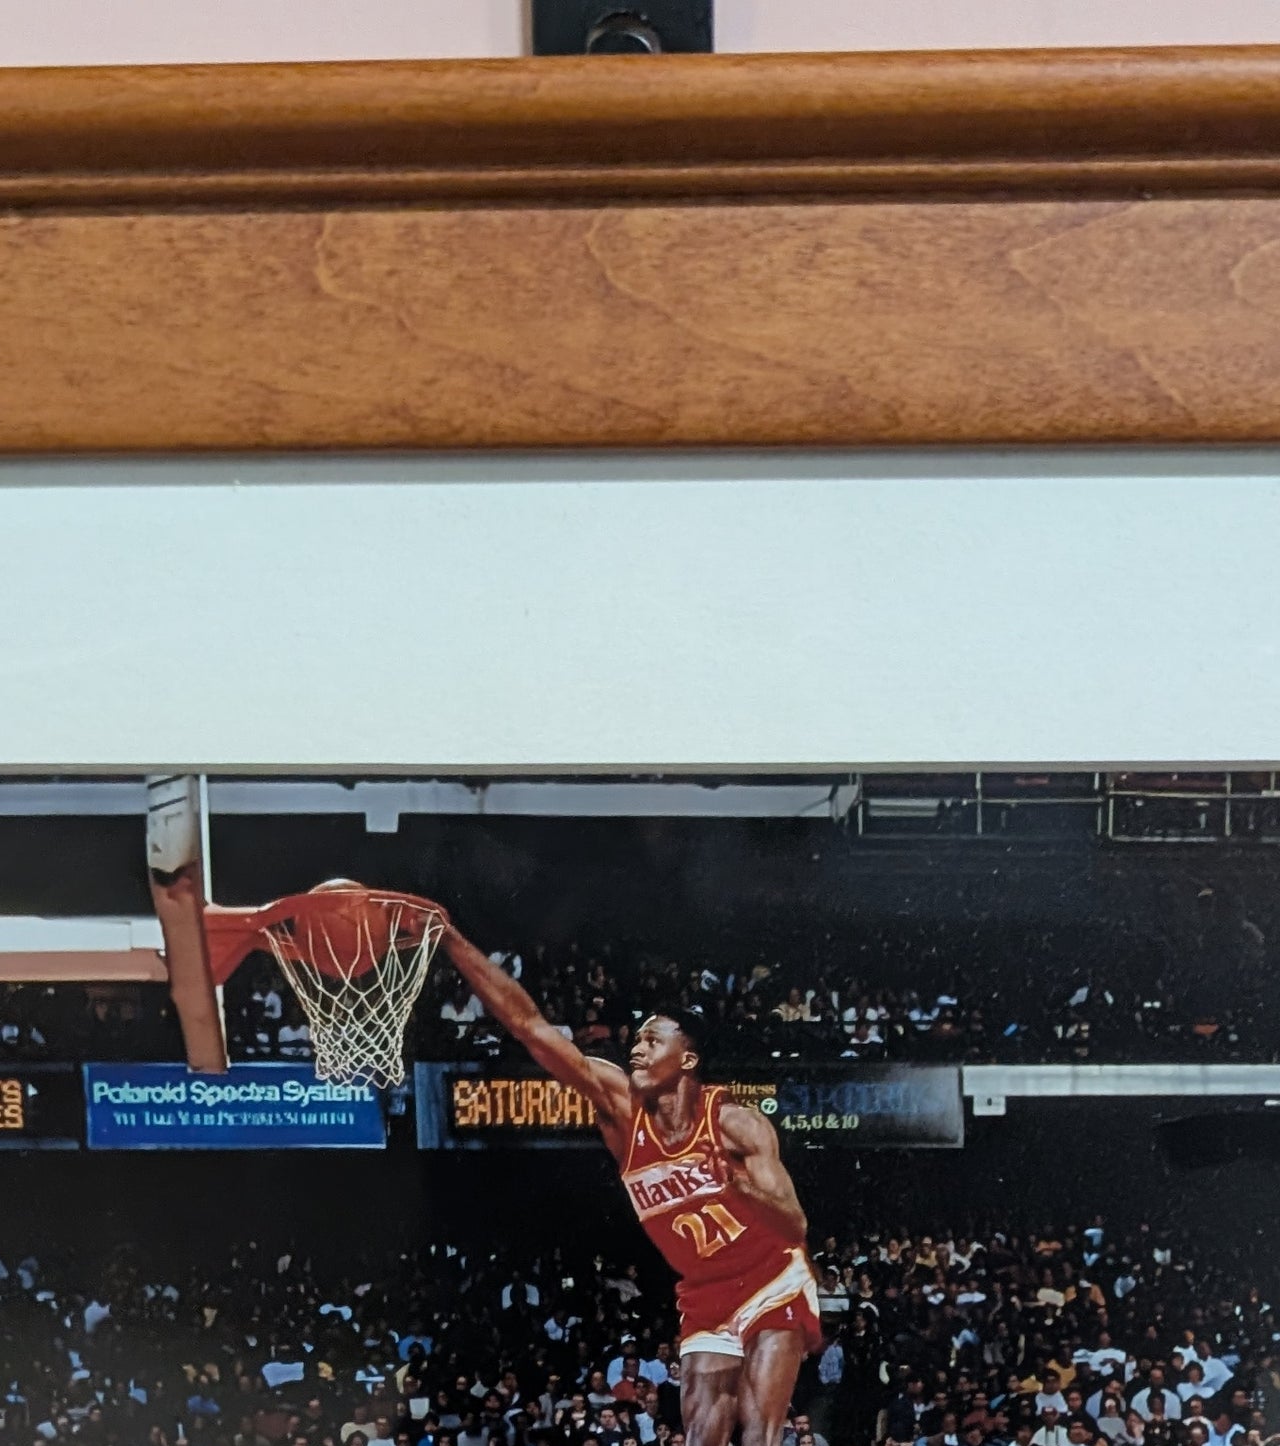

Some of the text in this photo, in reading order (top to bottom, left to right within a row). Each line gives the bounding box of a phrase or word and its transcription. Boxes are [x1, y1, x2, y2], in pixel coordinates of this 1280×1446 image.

[93, 1081, 187, 1104] Polaroid
[190, 1081, 280, 1107] Spectra
[671, 1202, 748, 1258] 21
